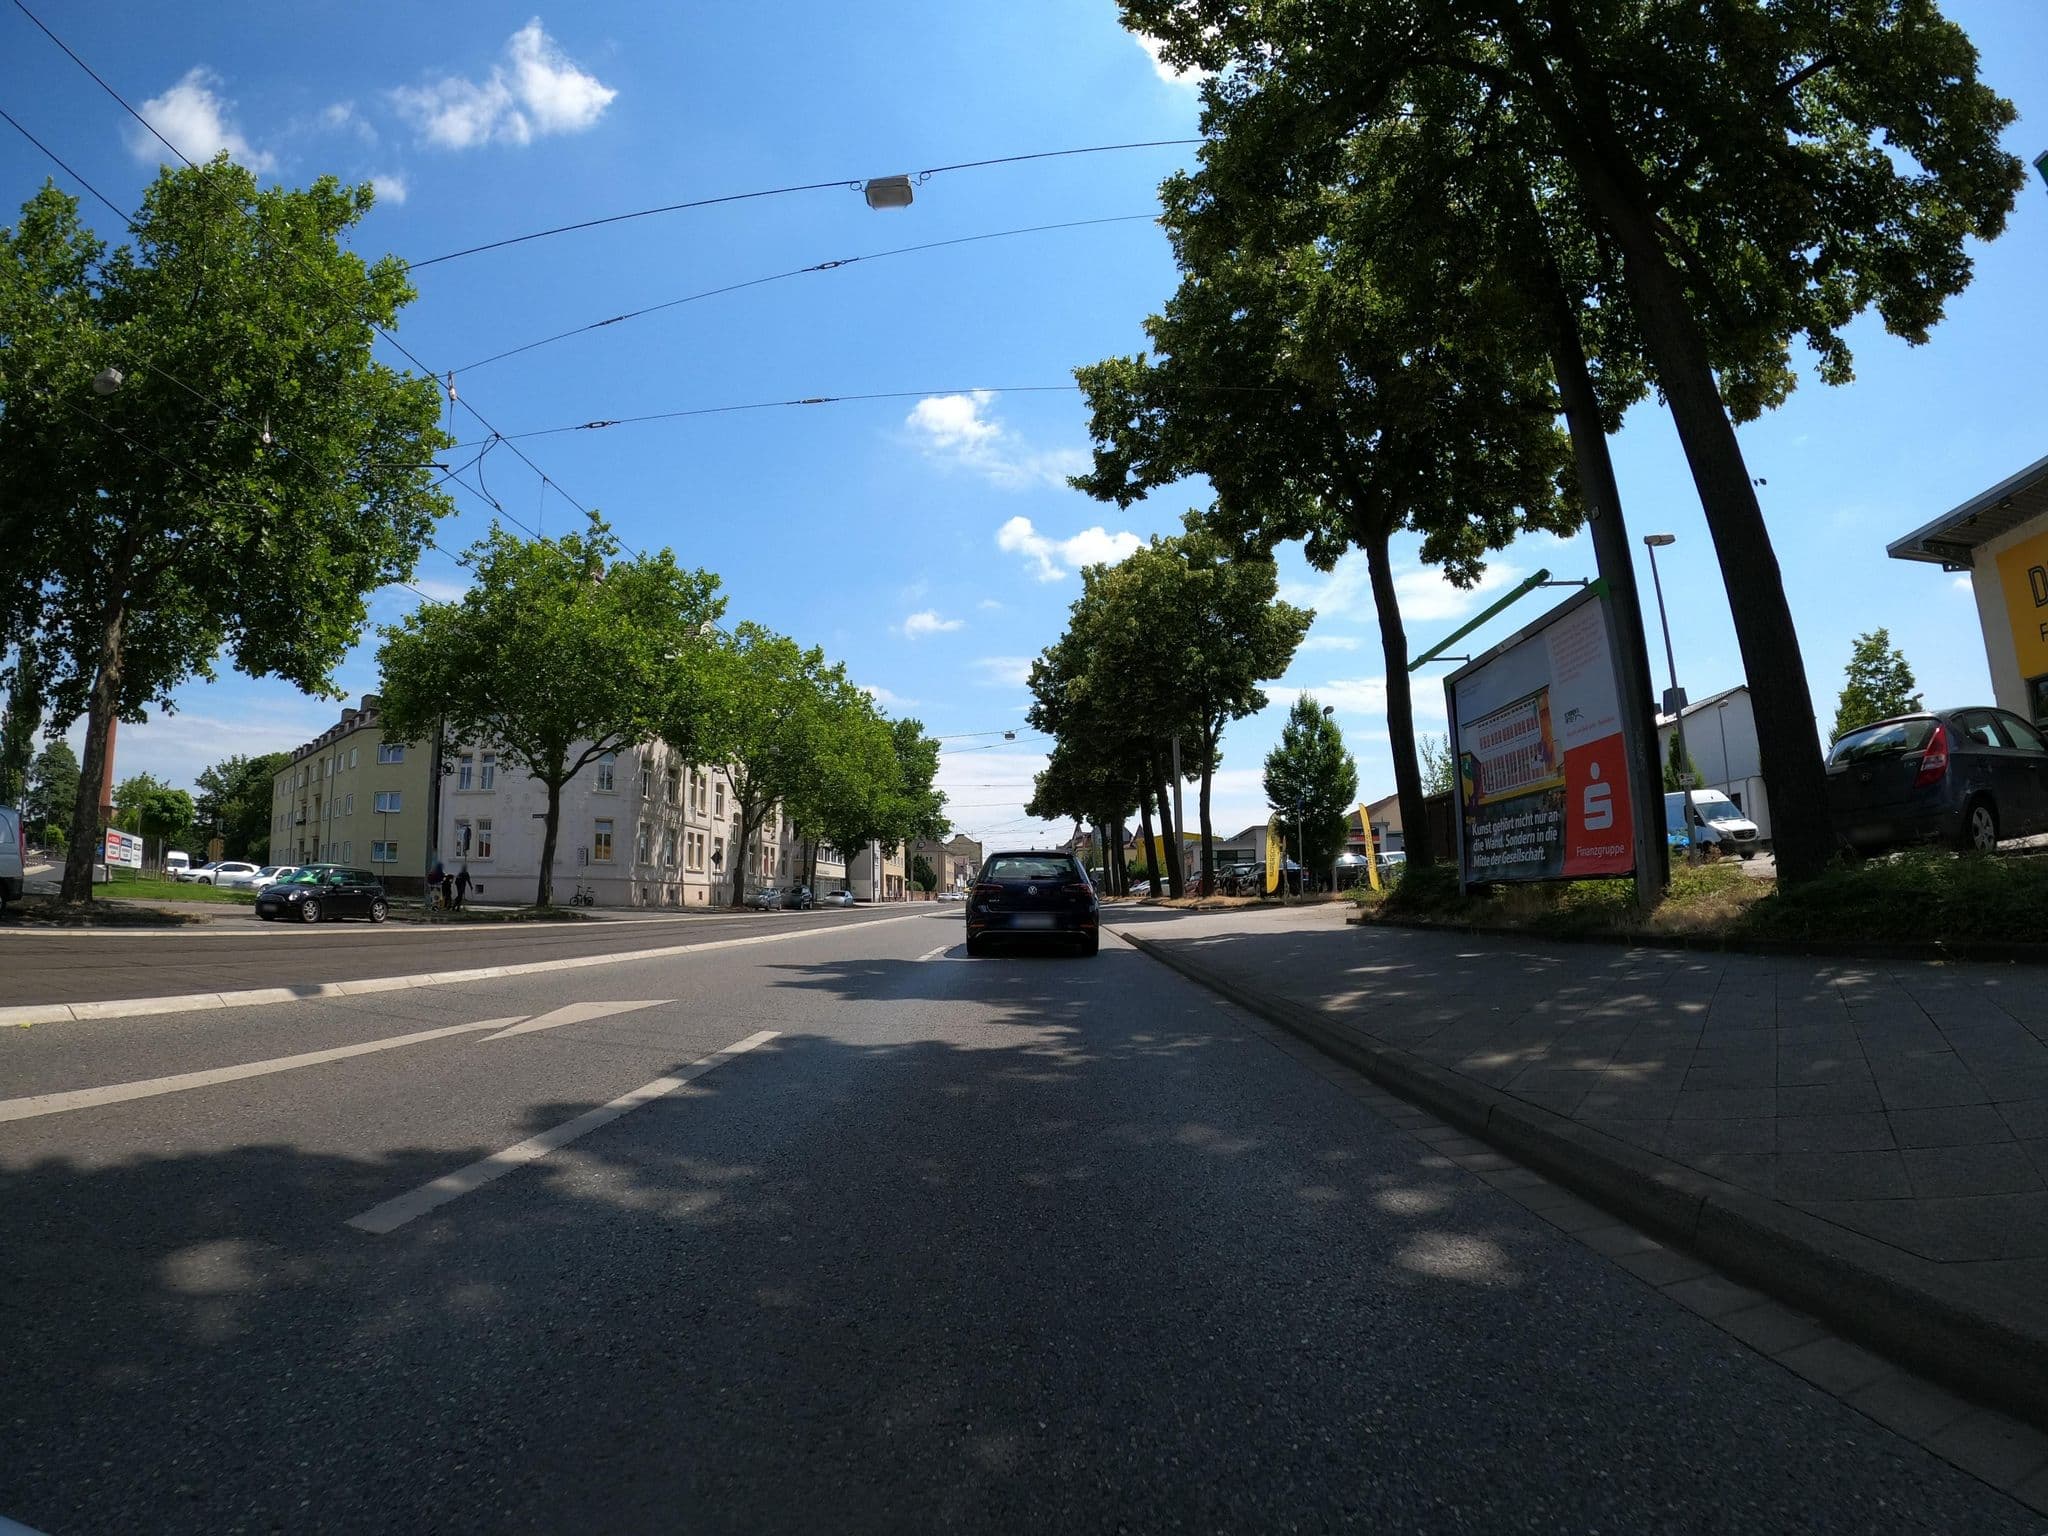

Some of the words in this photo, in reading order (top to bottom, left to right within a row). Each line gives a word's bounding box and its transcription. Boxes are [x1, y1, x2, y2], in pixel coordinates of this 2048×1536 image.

[1472, 821, 1492, 837] Kunst
[1493, 815, 1514, 836] gehört
[1515, 811, 1534, 829] nicht
[1534, 813, 1547, 825] nur
[1473, 838, 1484, 852] die
[1485, 836, 1504, 850] Wand.
[1505, 831, 1535, 848] Sondern
[1536, 828, 1544, 843] in
[1545, 826, 1558, 841] die
[1576, 843, 1625, 859] Finanzgruppe
[1473, 854, 1490, 868] Mitte
[1490, 852, 1502, 866] der
[1502, 846, 1546, 864] Gesellschaft.
